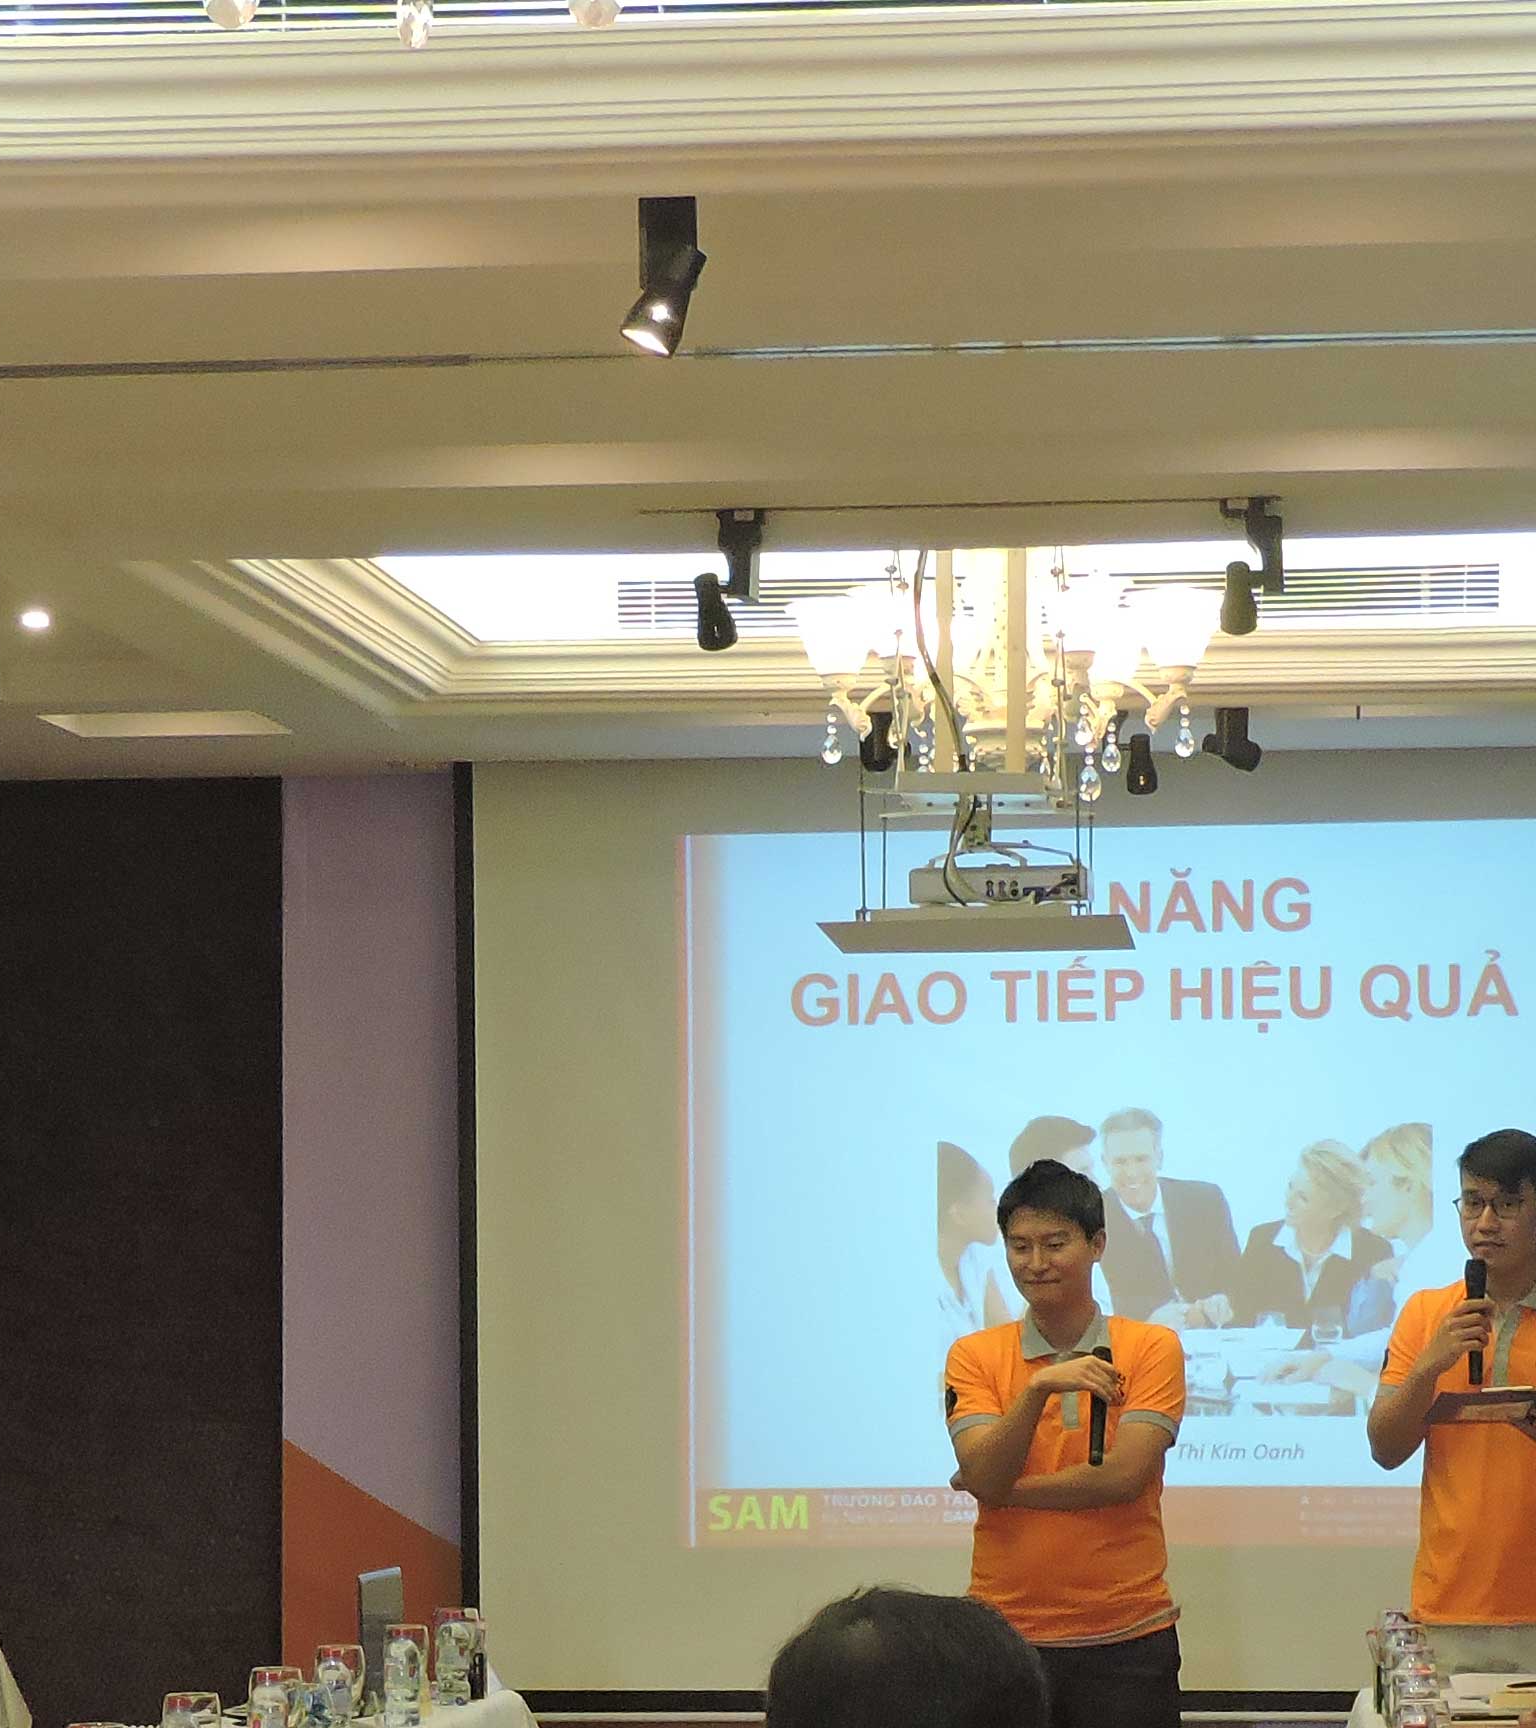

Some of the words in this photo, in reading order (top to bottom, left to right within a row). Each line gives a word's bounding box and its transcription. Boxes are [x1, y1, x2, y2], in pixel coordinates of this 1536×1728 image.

[1109, 867, 1312, 933] NĂNG
[790, 971, 968, 1027] GIAO
[989, 956, 1145, 1023] TIẾP
[1170, 960, 1332, 1033] HIỆU
[1360, 949, 1519, 1021] QUẢ
[1211, 1443, 1246, 1461] Kim
[1253, 1443, 1304, 1461] Oanh
[708, 1494, 809, 1531] SAM
